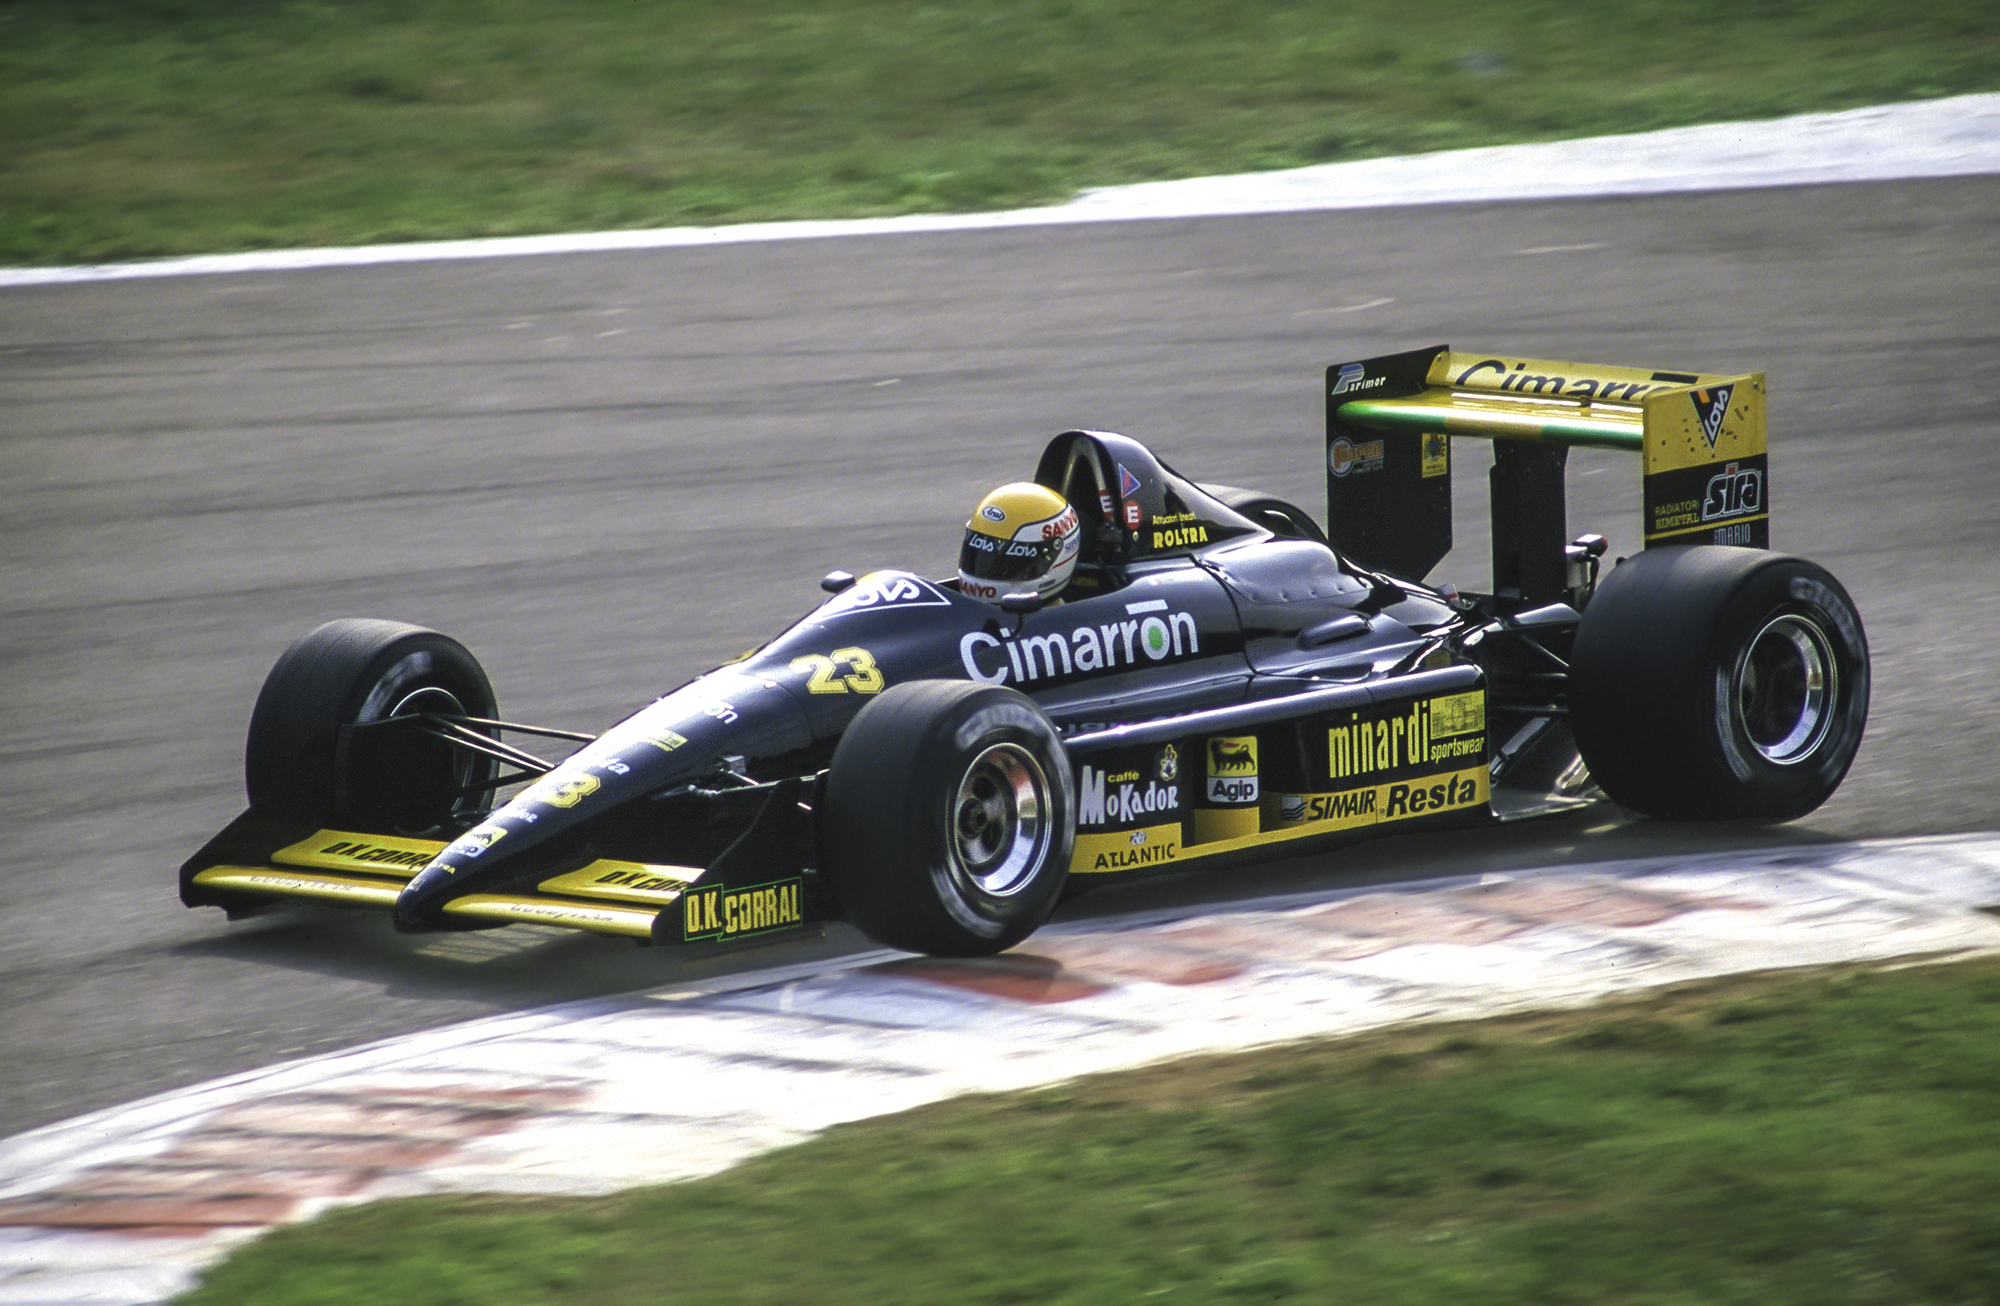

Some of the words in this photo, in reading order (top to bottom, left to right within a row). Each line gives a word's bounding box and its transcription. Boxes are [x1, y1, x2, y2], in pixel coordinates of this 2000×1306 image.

[1127, 505, 1139, 524] E
[1655, 499, 1699, 516] RADIATORI
[1655, 512, 1700, 530] BIMETAL
[968, 533, 994, 552] Lois
[1005, 541, 1038, 557] Lois
[1152, 526, 1208, 549] ROLTRA
[789, 645, 886, 695] 23
[1328, 700, 1429, 779] minardi
[1430, 736, 1485, 764] sportswear
[1212, 780, 1255, 802] Agip
[1386, 773, 1477, 818] Resta
[1307, 788, 1377, 821] SIMAIR
[353, 848, 436, 869] CORRA
[1094, 842, 1176, 870] ATLANTIC
[687, 891, 722, 933] O.K.
[724, 884, 801, 934] CORRAL
